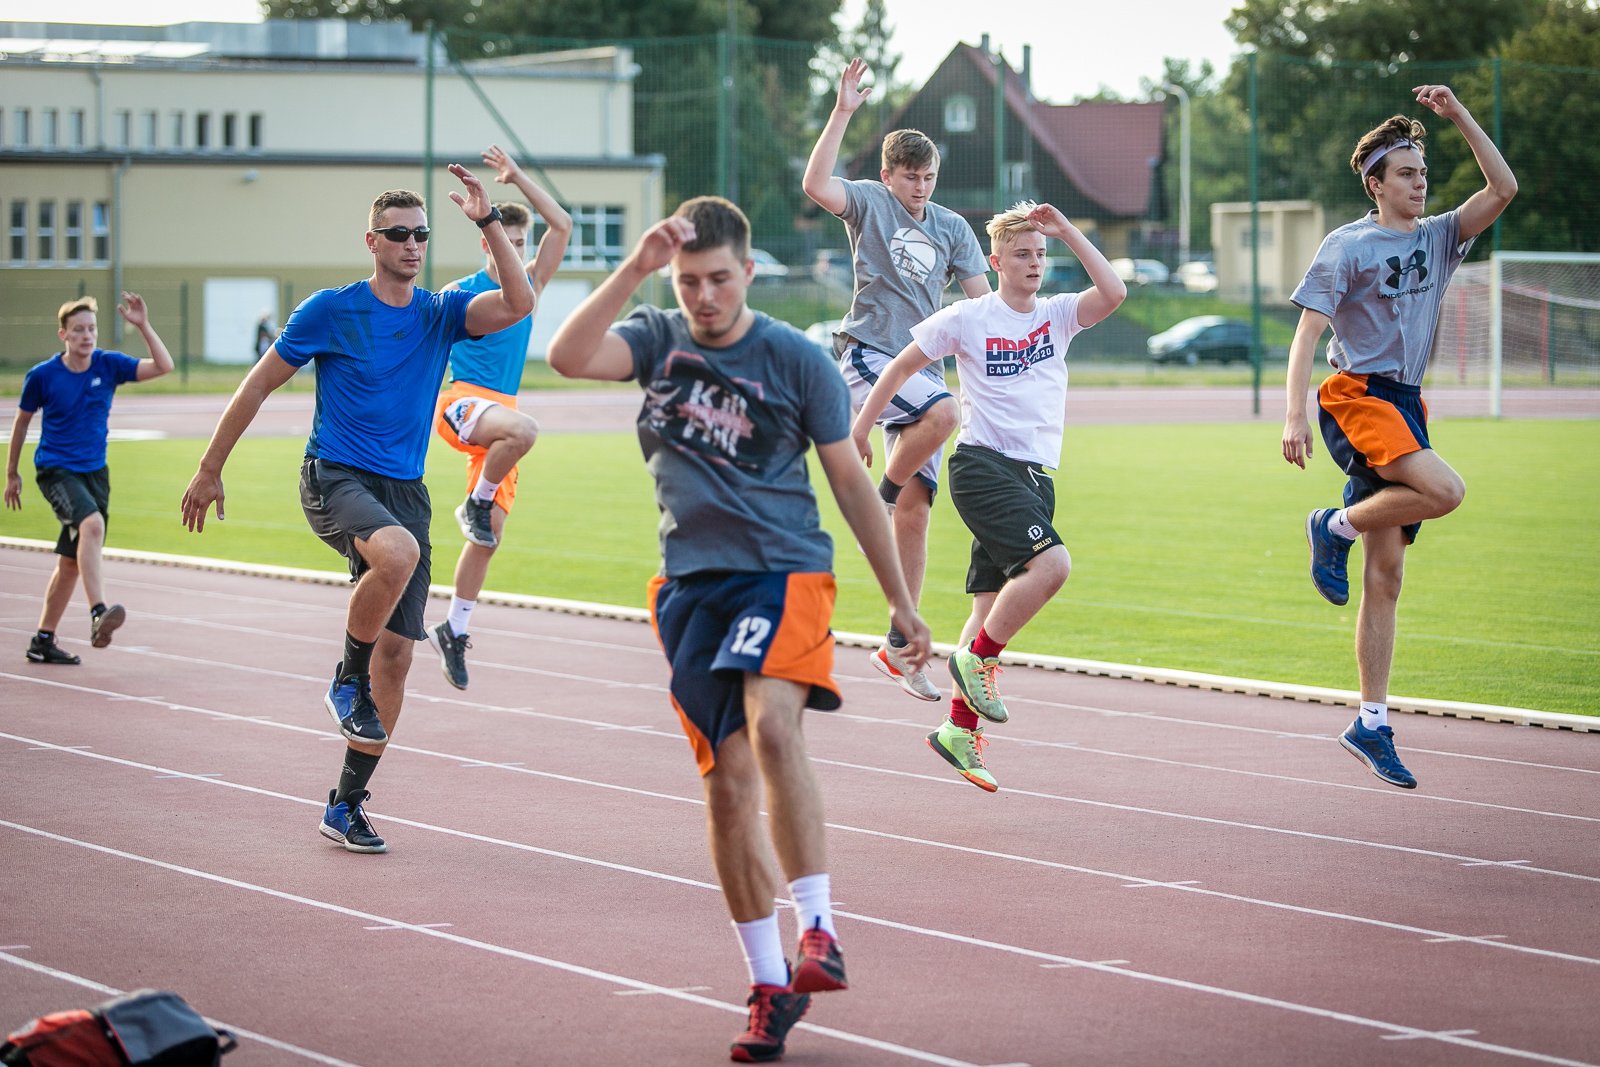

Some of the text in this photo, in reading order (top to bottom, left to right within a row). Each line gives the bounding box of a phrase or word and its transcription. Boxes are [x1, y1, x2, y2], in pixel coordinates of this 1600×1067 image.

[986, 320, 1051, 361] DRAFT
[989, 366, 1016, 374] CAMP
[731, 616, 771, 657] 12
